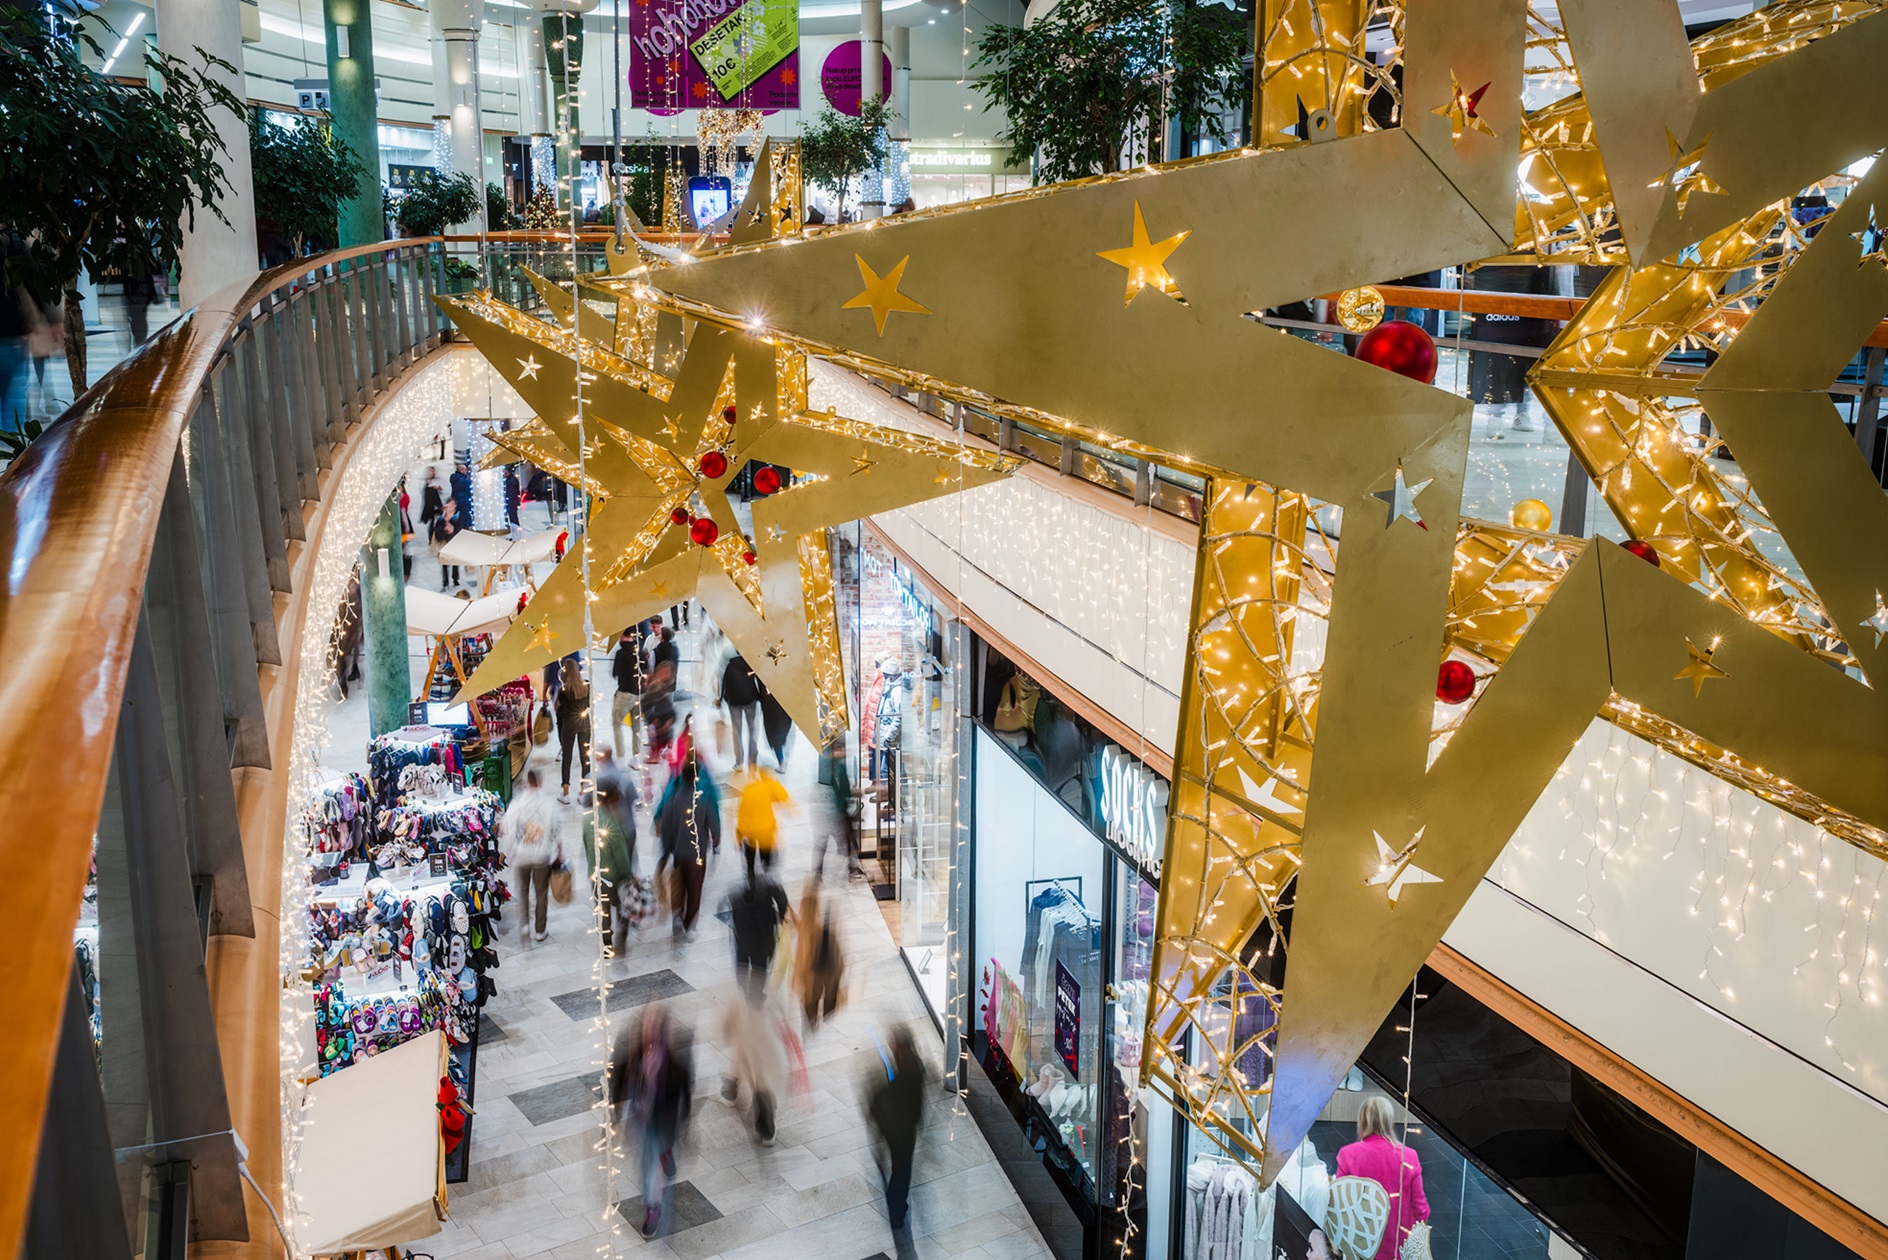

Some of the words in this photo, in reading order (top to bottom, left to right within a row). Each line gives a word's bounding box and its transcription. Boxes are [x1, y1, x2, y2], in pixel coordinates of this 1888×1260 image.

[694, 12, 747, 56] DESETAK
[301, 94, 310, 105] P
[769, 90, 798, 98] Podarite
[769, 99, 795, 107] veseje.
[909, 150, 992, 166] stradivarius
[1100, 745, 1159, 861] SOCKS
